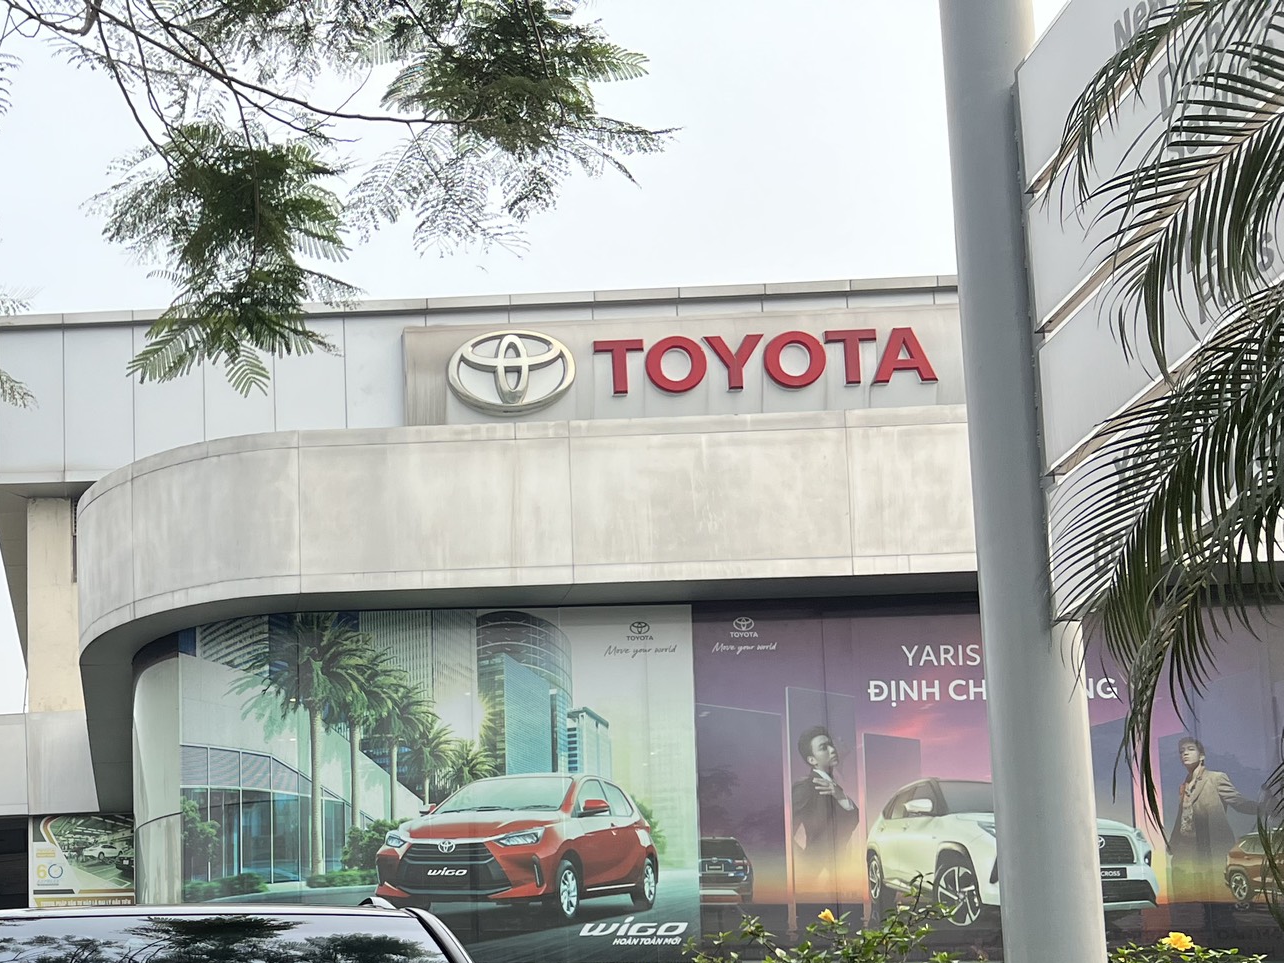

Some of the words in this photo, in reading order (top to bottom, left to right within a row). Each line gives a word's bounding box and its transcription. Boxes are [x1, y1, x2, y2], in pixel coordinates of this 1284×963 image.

[593, 327, 939, 396] TOYOTA
[603, 645, 630, 657] Move
[632, 647, 652, 659] your
[654, 644, 678, 653] world
[711, 642, 736, 653] Move
[737, 644, 755, 655] your
[756, 642, 778, 651] world
[901, 644, 981, 666] YARIS
[868, 679, 940, 707] ĐỊNH
[948, 679, 987, 701] CH
[612, 936, 640, 945] HOÀN
[639, 936, 664, 945] TOÀN
[662, 935, 682, 945] MỚI
